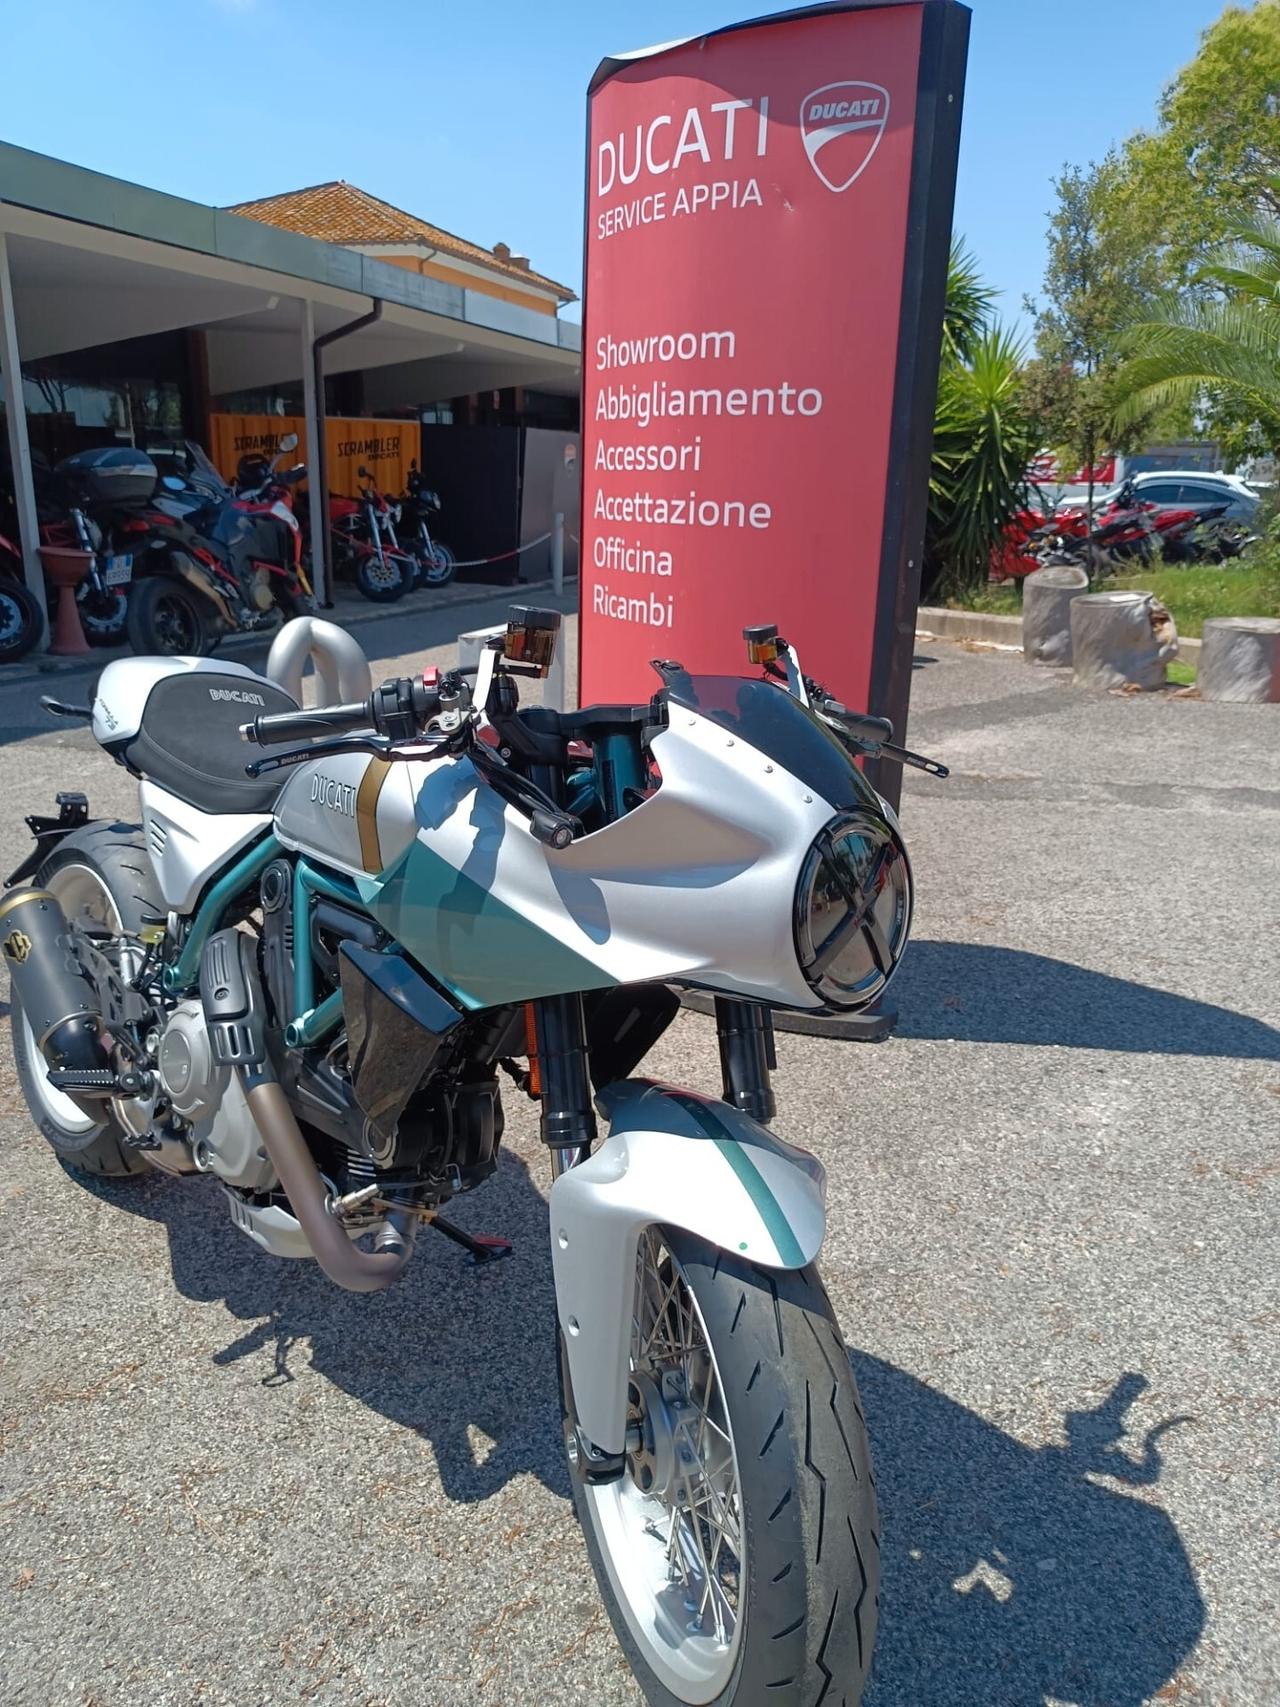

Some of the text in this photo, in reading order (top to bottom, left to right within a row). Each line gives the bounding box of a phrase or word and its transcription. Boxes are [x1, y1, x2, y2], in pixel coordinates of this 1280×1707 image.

[809, 99, 880, 121] DUCATI
[598, 96, 769, 197] DUCATI
[597, 178, 763, 240] SERVICE APPIA
[596, 329, 736, 371] Showroom
[595, 381, 824, 428] Abbigliamento
[337, 436, 400, 458] SCRAMBLER
[594, 436, 702, 472] Accessori
[594, 488, 772, 529] Accettazione
[593, 536, 673, 577] Officina
[593, 583, 673, 628] Ricambi
[209, 688, 265, 707] DUCATI
[280, 752, 310, 765] DUCATI
[310, 773, 356, 818] DUCATI
